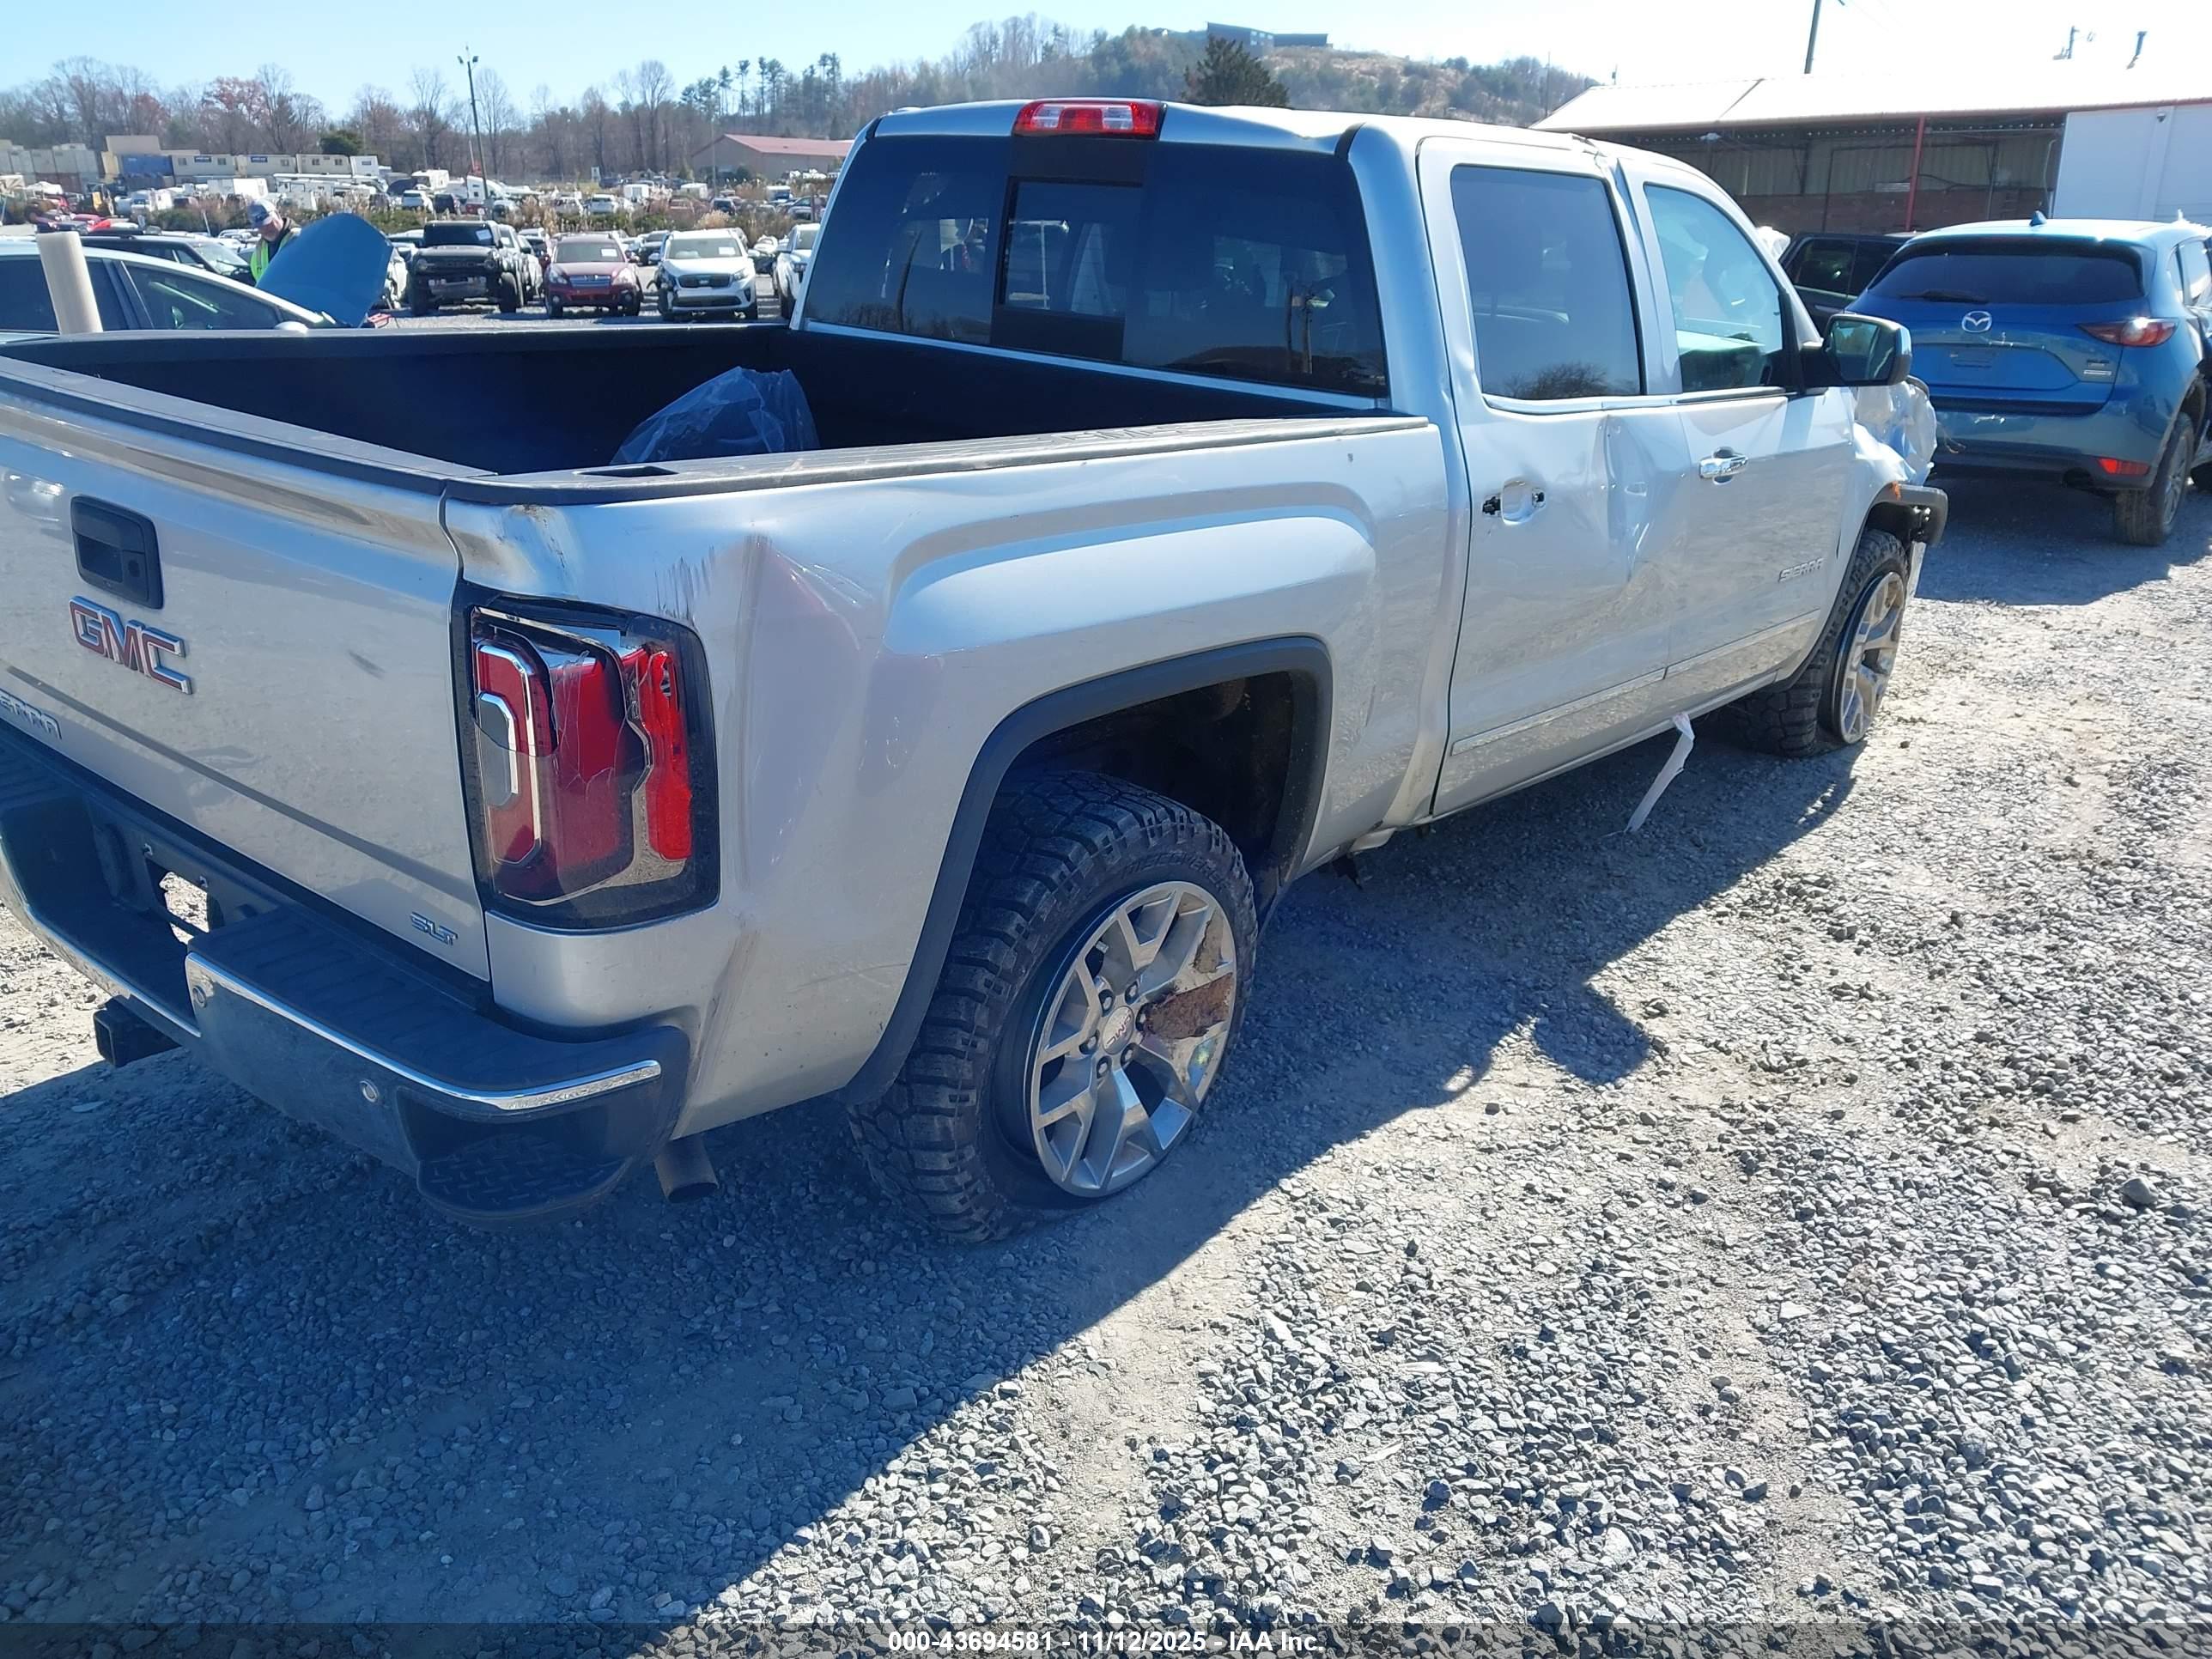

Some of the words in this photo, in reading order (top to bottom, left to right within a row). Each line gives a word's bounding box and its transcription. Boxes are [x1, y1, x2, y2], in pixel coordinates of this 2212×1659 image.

[1778, 557, 1824, 583] SIERRA
[69, 595, 193, 696] GMC
[410, 911, 459, 945] SLT
[1106, 1009, 1132, 1048] GMC
